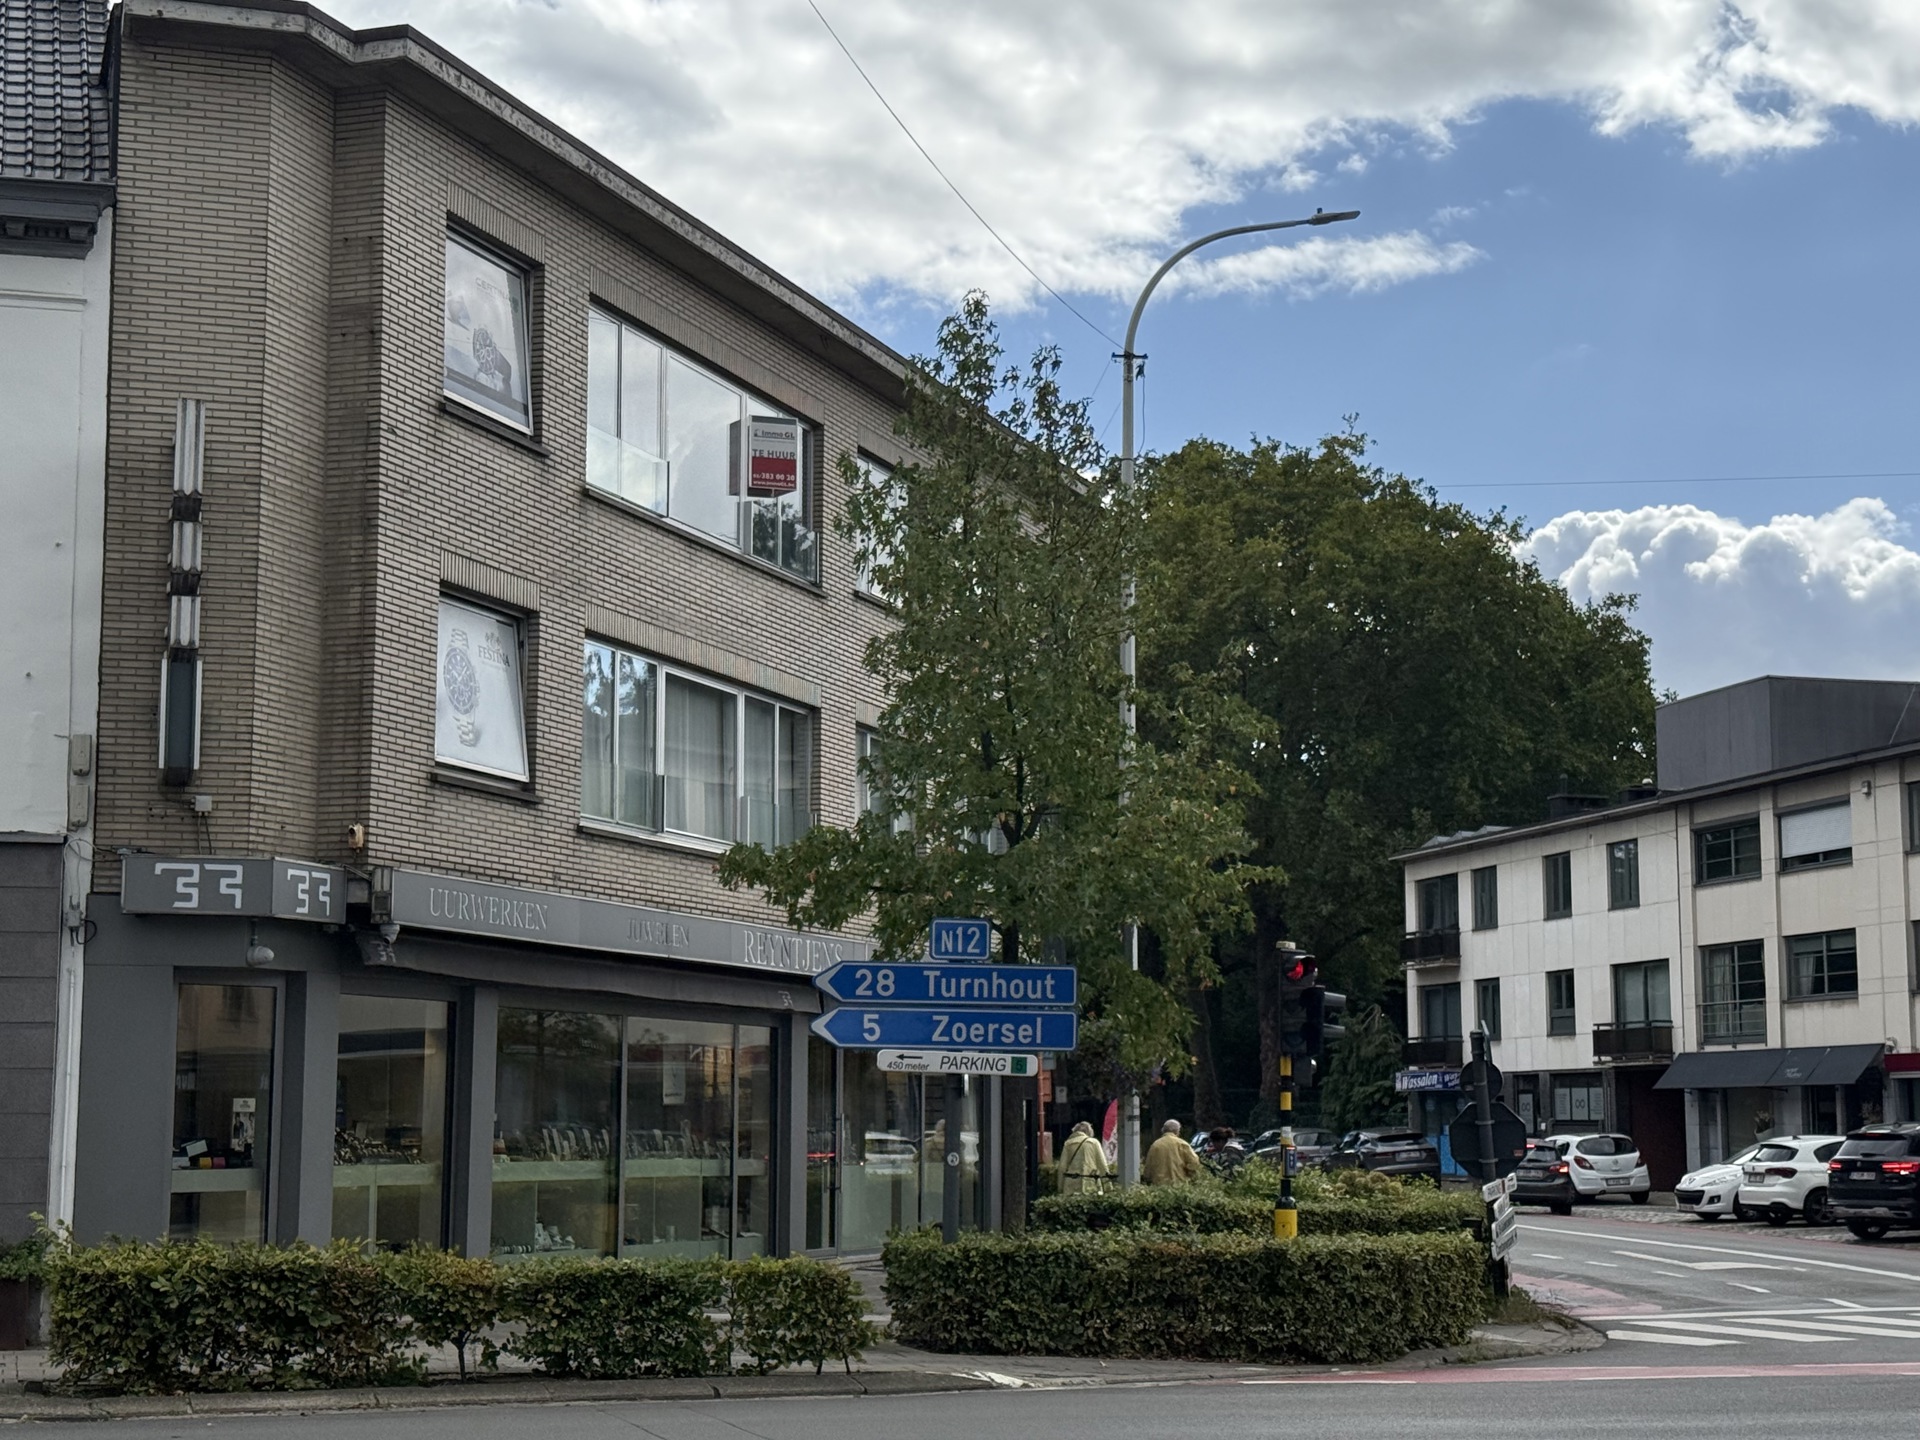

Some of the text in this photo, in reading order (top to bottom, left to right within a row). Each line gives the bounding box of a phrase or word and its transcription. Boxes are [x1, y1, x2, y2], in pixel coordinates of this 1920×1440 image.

[752, 449, 796, 459] TE HUUR
[478, 645, 510, 667] FESTINA
[429, 887, 548, 930] UURWERKEN
[627, 919, 690, 948] JUWELEN
[941, 926, 981, 953] N12
[855, 969, 1056, 999] 28 Turnhout
[862, 1013, 1042, 1044] 5 Zoersel
[887, 1061, 930, 1071] 450 meter
[940, 1055, 1007, 1071] PARKING
[1402, 1072, 1438, 1090] Wassalon
